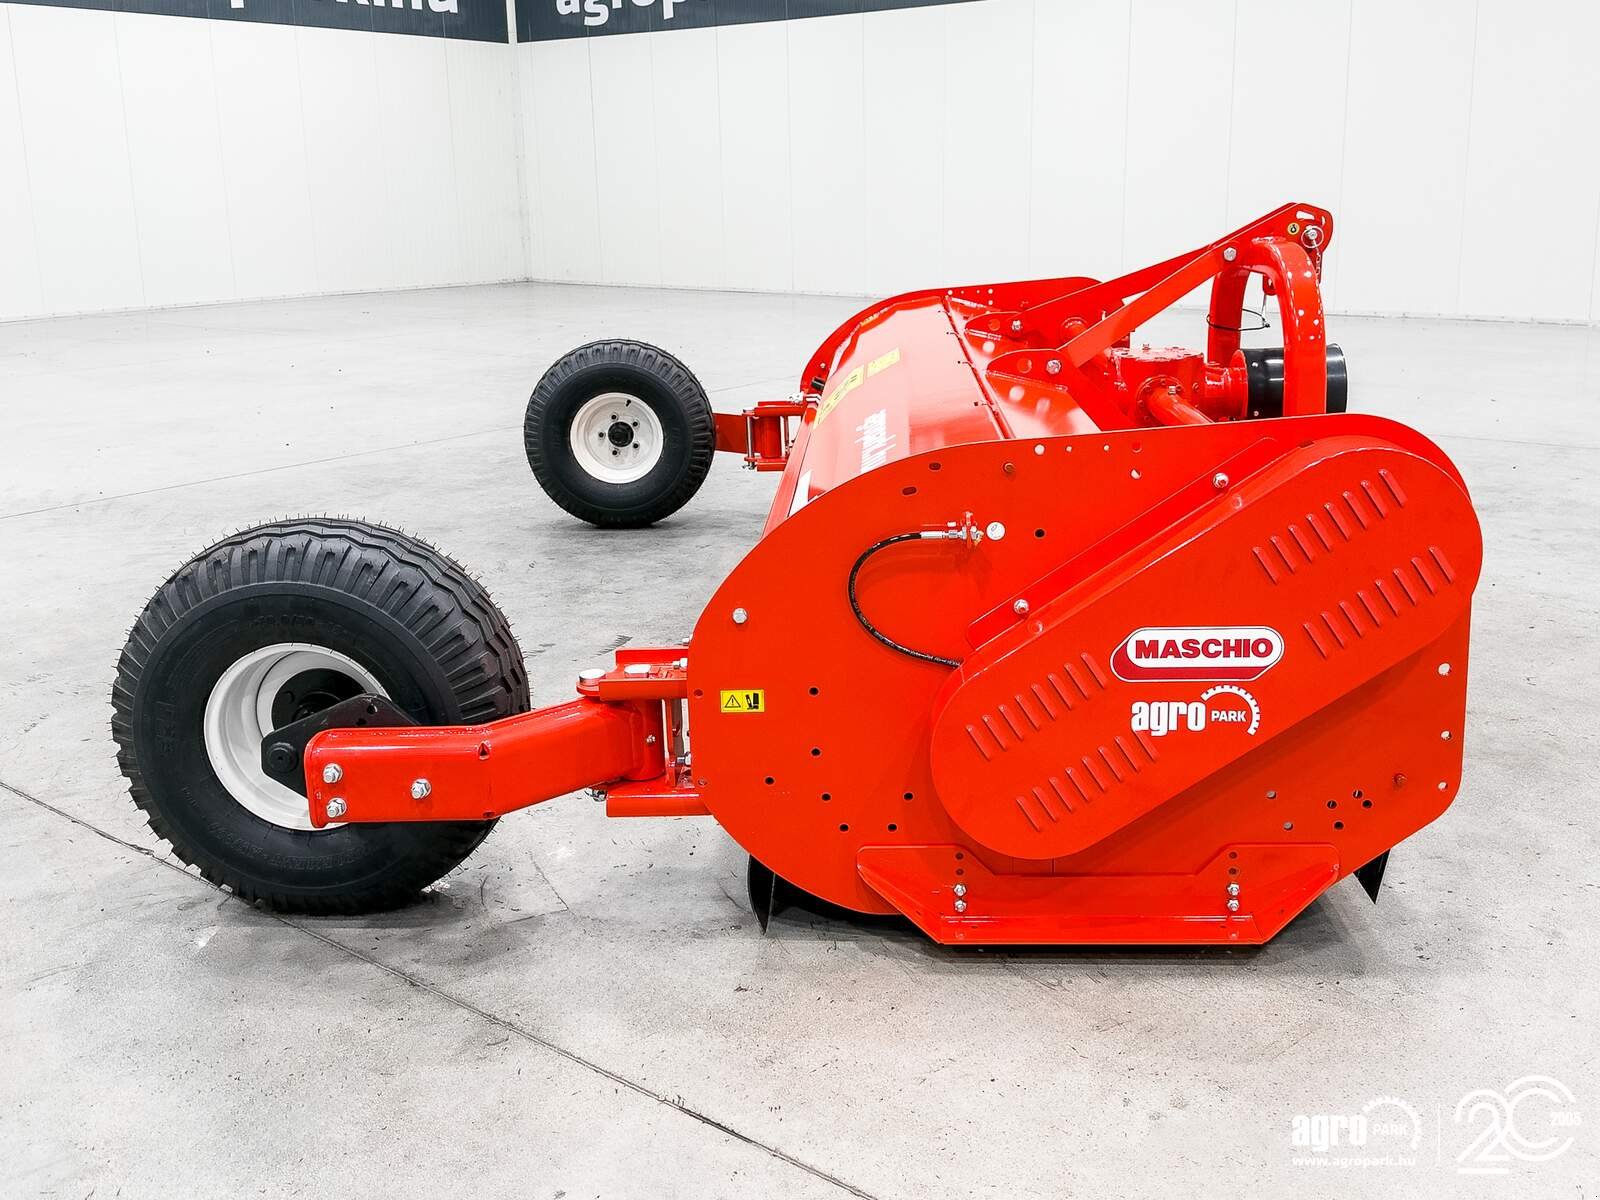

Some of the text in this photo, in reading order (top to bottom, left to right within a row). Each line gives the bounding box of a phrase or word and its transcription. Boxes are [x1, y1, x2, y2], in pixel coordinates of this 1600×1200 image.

[1135, 638, 1273, 659] MASCHIO
[1131, 701, 1247, 736] agro PARK
